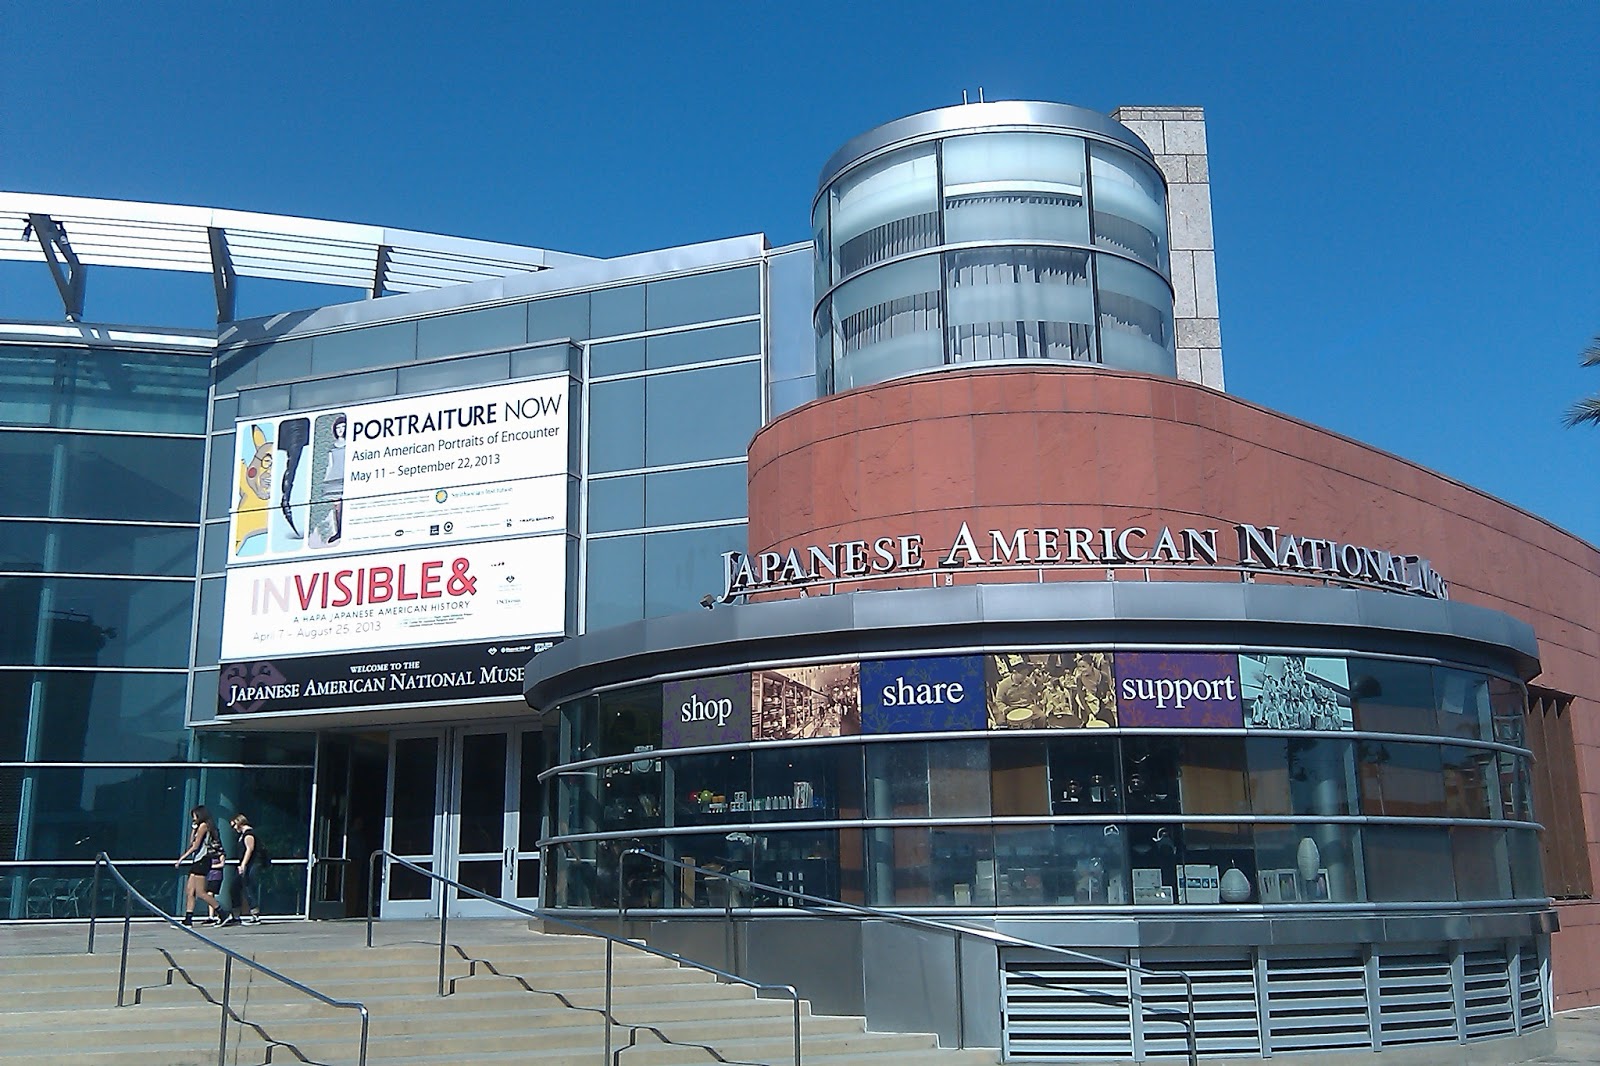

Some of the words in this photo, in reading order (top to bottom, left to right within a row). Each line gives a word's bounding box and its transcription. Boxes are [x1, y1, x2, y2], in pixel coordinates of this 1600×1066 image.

[353, 403, 497, 441] PORTRAITURE
[505, 394, 562, 421] NOW
[352, 449, 380, 461] Asian
[384, 442, 435, 458] American
[438, 435, 484, 452] Portraits
[487, 431, 499, 444] of
[501, 427, 560, 443] Encounter
[351, 471, 371, 485] May
[375, 468, 385, 478] 11
[398, 459, 455, 477] September
[457, 457, 473, 469] 22,
[475, 454, 501, 466] 2013
[717, 534, 924, 603] JAPANESE
[942, 520, 1218, 565] AMERICAN
[1234, 523, 1413, 586] NATIONAL
[303, 613, 327, 622] HAPA
[329, 609, 374, 622] JAPANESE
[378, 604, 427, 616] AMERICAN
[430, 601, 471, 612] HISTORY
[253, 631, 275, 643] Apri
[279, 629, 285, 639] 7
[297, 627, 333, 639] August
[355, 620, 381, 634] 2013
[350, 664, 388, 674] WELCOME
[390, 662, 402, 671] TO
[403, 661, 420, 669] THE
[227, 684, 300, 706] JAPANESE
[303, 678, 387, 697] AMERICAN
[389, 671, 475, 691] NATIONAL
[883, 677, 965, 706] share
[1122, 675, 1237, 708] support
[681, 694, 732, 726] shop
